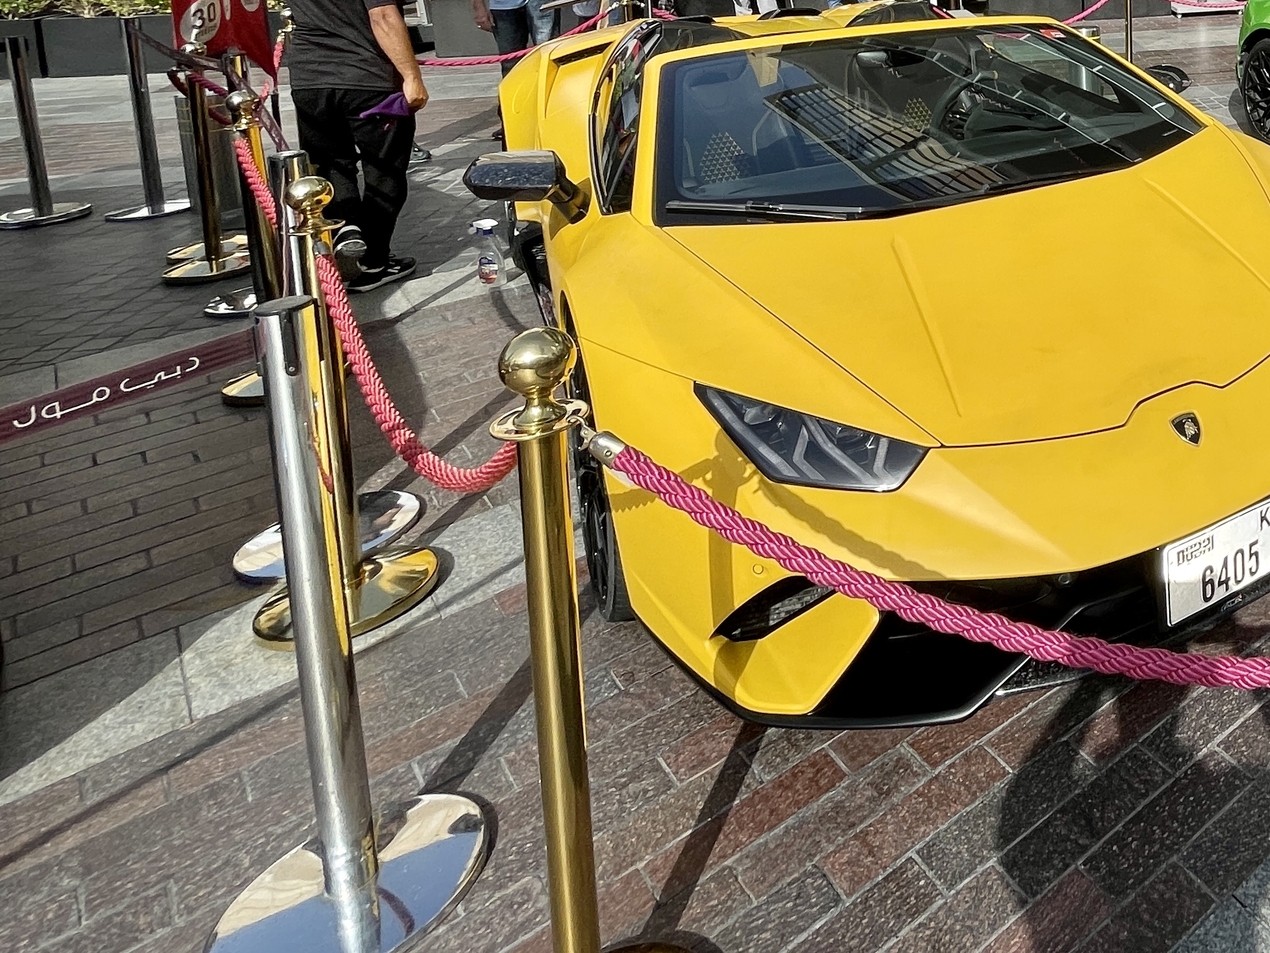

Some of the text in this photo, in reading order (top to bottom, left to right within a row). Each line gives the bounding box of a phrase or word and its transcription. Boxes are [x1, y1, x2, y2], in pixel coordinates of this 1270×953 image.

[191, 2, 217, 29] 30
[12, 356, 200, 429] دبي مول
[1201, 538, 1260, 603] 6405
